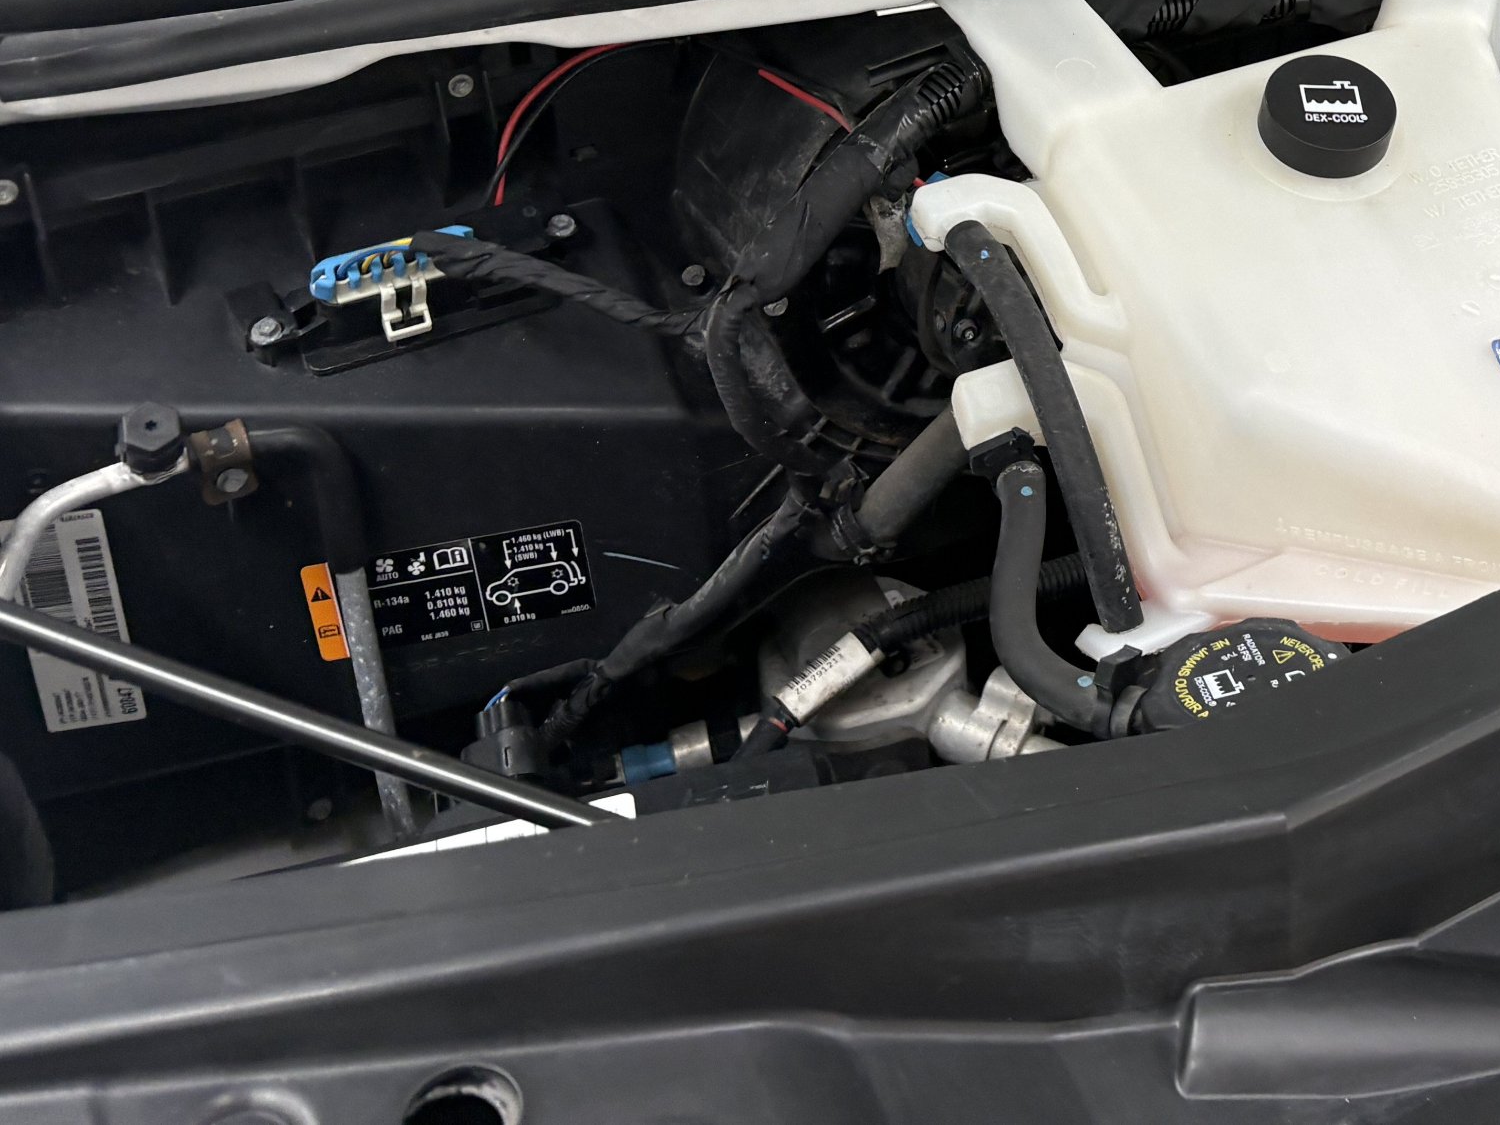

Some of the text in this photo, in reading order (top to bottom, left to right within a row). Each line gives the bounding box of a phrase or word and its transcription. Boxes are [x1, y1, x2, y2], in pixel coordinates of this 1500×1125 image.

[543, 528, 565, 540] (LWB)
[515, 551, 538, 562] (SWB)
[376, 571, 399, 582] AUTO
[1317, 564, 1450, 598] COLD FILL
[424, 585, 466, 600] 1.410 kg
[456, 596, 468, 607] kg
[458, 606, 470, 618] kg
[525, 612, 536, 622] kg
[382, 625, 403, 636] PAG
[1210, 638, 1231, 651] NE
[1242, 633, 1265, 666] RADIATOR
[1280, 636, 1324, 672] NEVER OPE
[1178, 647, 1209, 677] JAMAIS
[1175, 678, 1203, 713] OUVRIR
